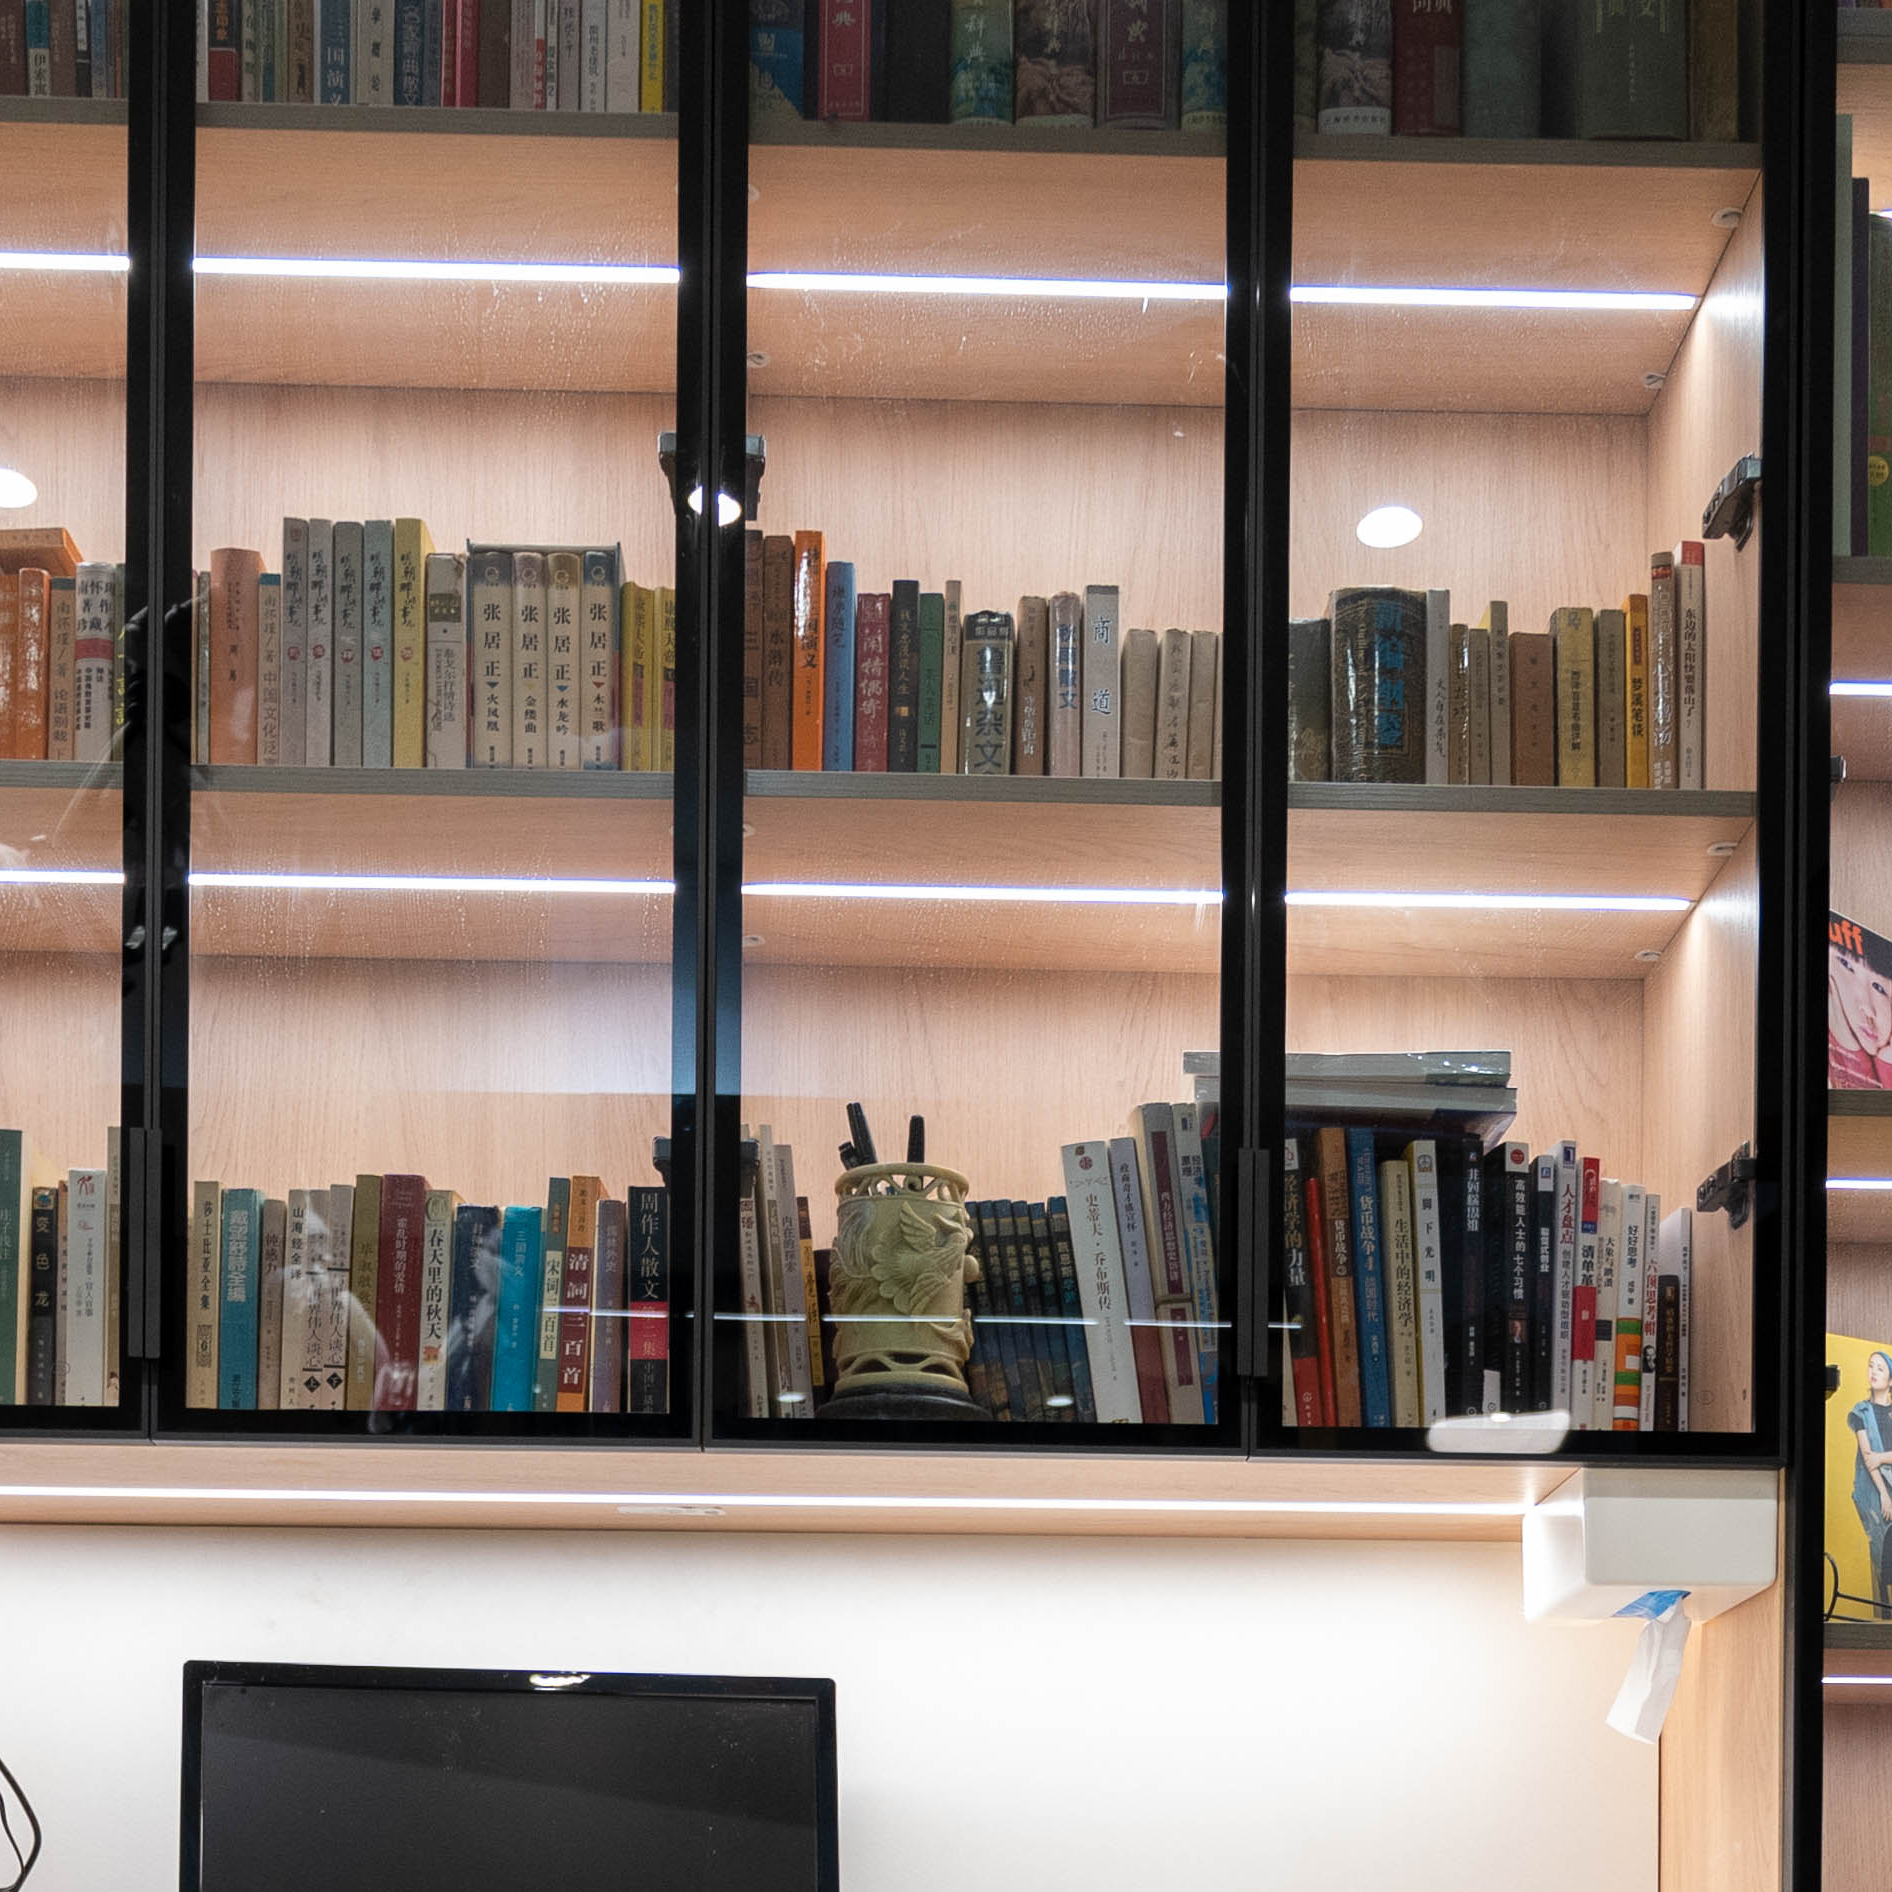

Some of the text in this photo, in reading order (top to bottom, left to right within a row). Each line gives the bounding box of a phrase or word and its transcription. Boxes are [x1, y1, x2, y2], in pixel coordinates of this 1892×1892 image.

[483, 603, 501, 678] 张居正
[521, 605, 539, 680] 张居正
[553, 607, 571, 681] 张居正
[589, 603, 607, 678] 张居正
[1092, 616, 1111, 715] 商道
[640, 1192, 659, 1299] 周作人散文
[1085, 1192, 1110, 1312] 史蒂夫·乔布斯传
[1333, 1220, 1348, 1266] 货币战争
[1359, 1195, 1377, 1256] 货币战争
[1512, 1178, 1528, 1301] 高效能人士的七个习惯
[1559, 1183, 1575, 1245] 人才盘点
[1627, 1224, 1639, 1269] 好好思考
[200, 1200, 213, 1311] 莎士比亚全集
[426, 1228, 444, 1340] 春天里的秋天
[1394, 1217, 1414, 1330] 生活中的经济学
[1644, 1259, 1658, 1337] 六顶思考帽
